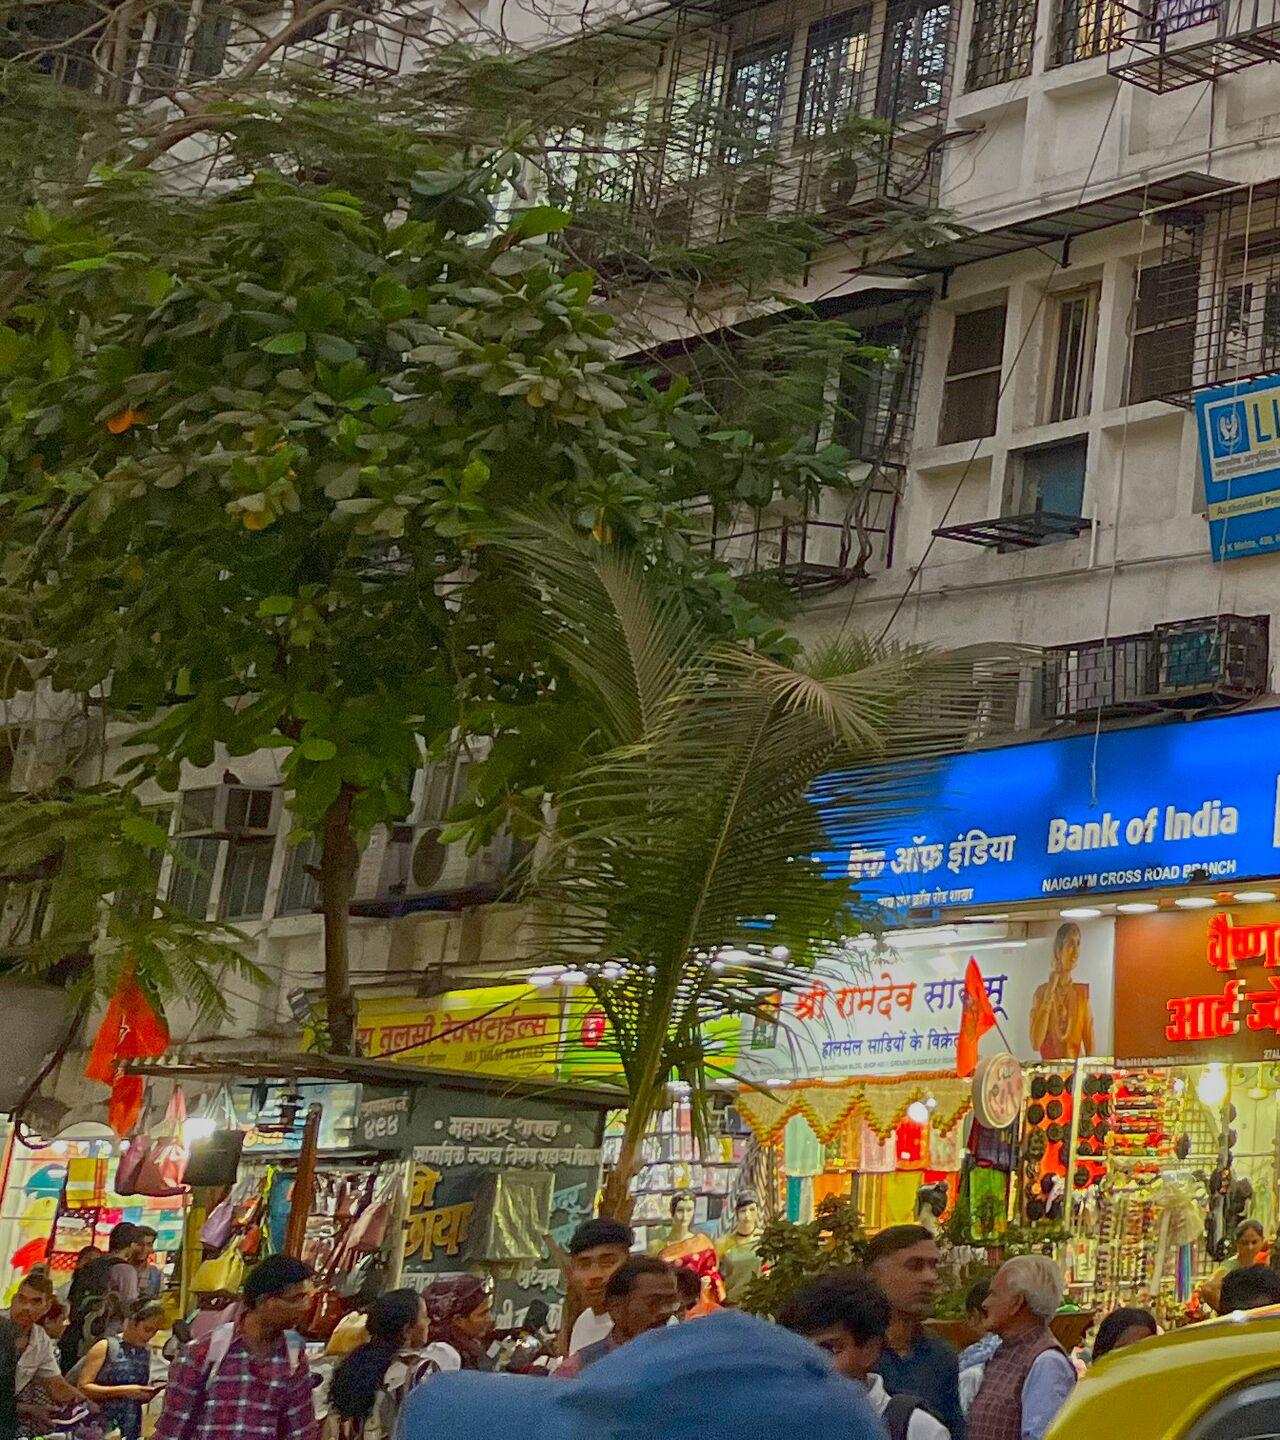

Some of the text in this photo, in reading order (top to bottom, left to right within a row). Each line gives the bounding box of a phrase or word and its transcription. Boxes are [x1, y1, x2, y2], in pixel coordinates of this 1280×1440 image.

[1047, 800, 1239, 854] Bank of India
[947, 829, 1016, 875] इंडिया
[1100, 869, 1142, 886] CROSS
[1144, 865, 1180, 881] ROAD
[835, 973, 917, 1020] रामदेव
[1166, 979, 1246, 1041] आर्ट
[822, 1037, 863, 1058] होलसेल
[909, 1032, 923, 1051] के
